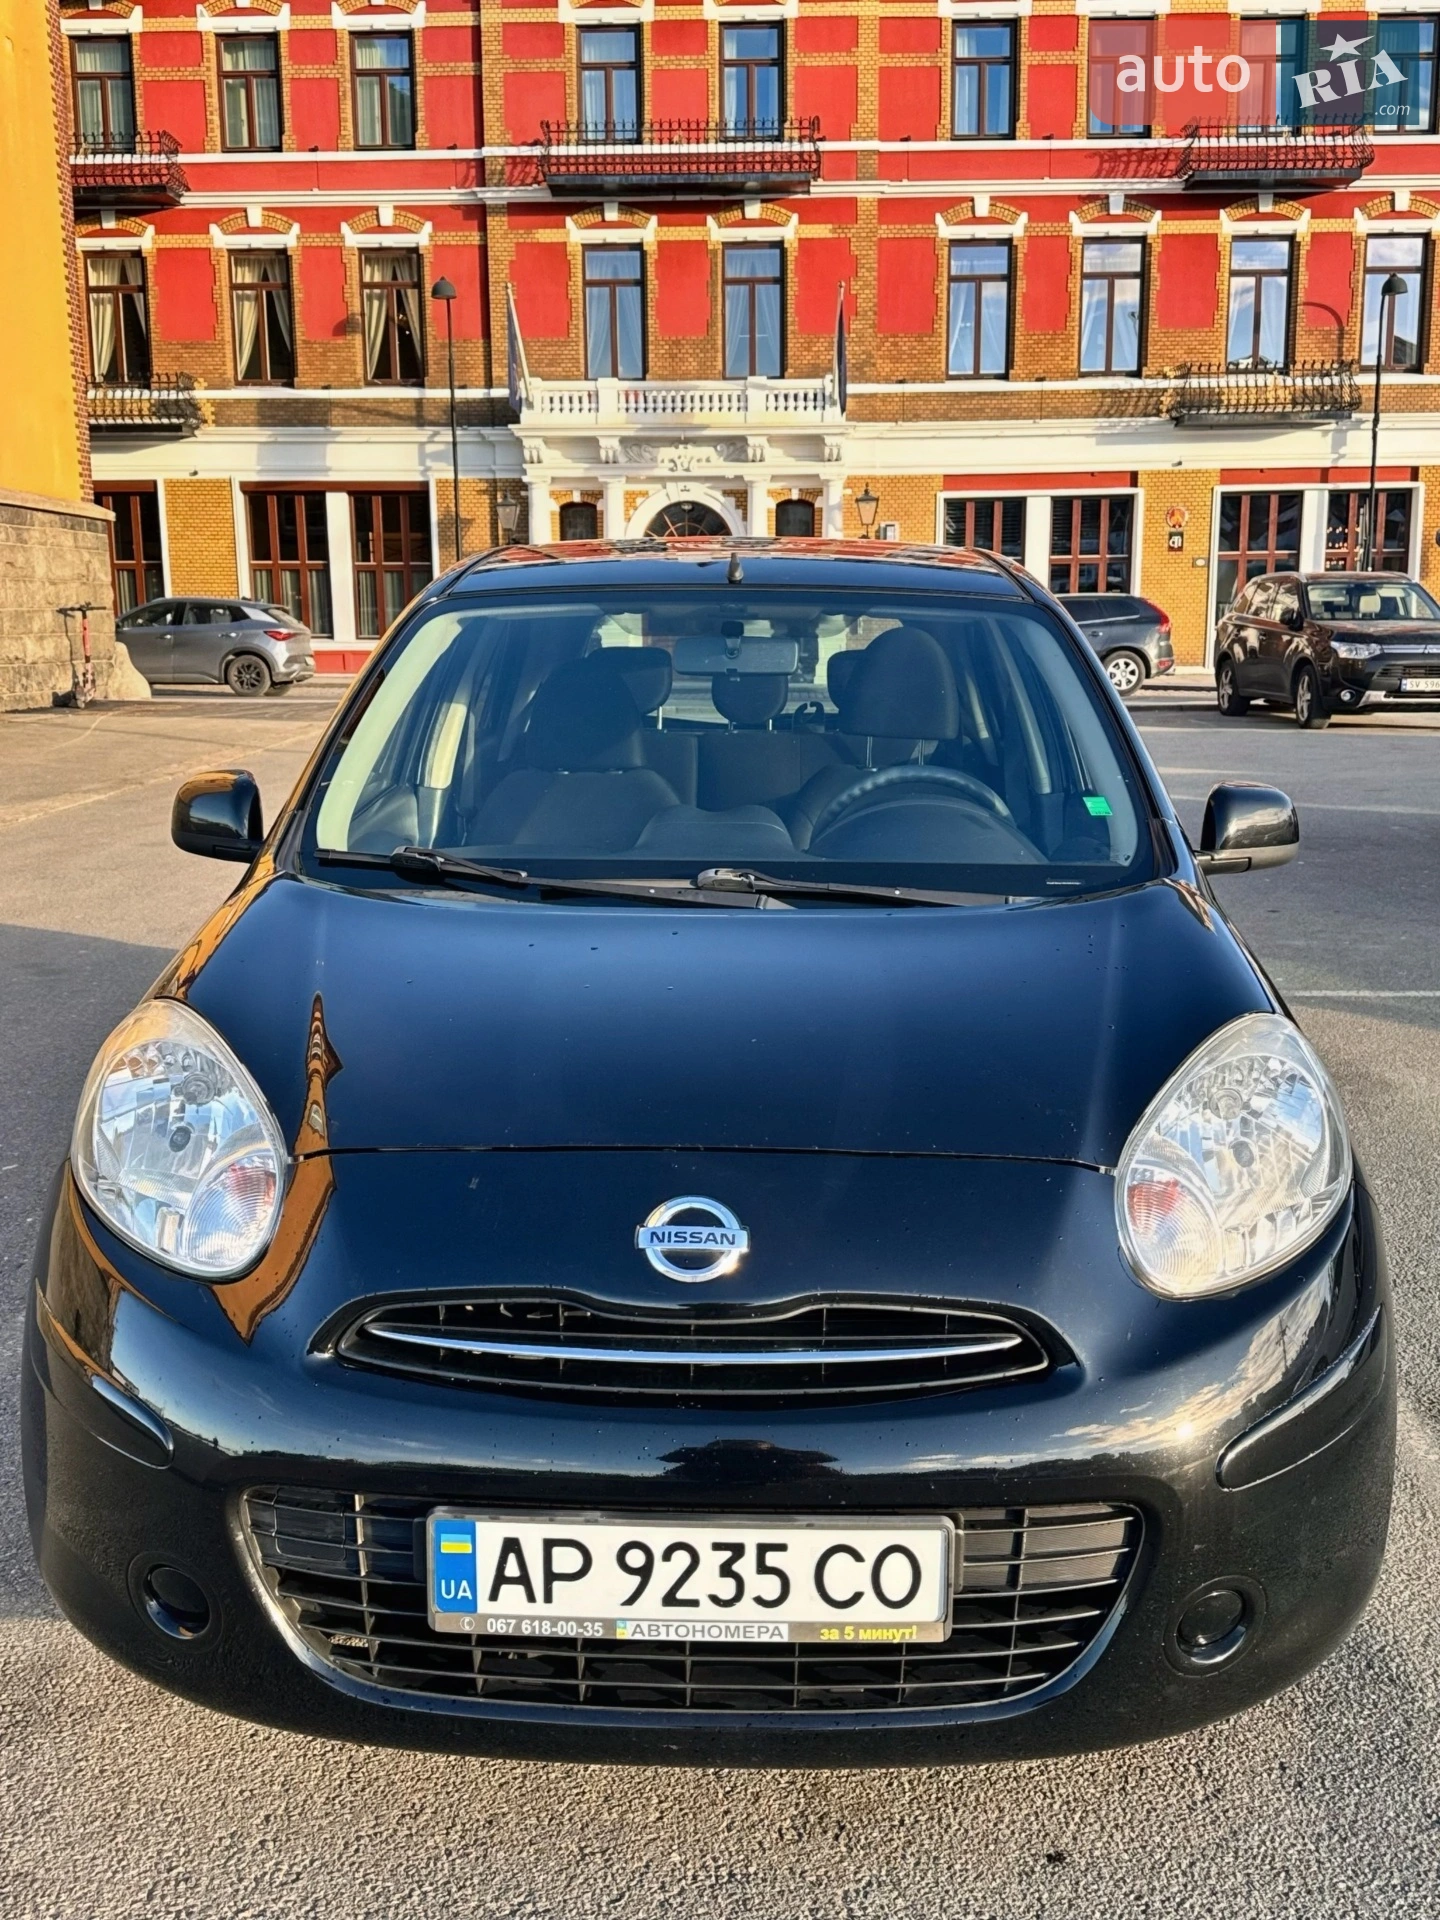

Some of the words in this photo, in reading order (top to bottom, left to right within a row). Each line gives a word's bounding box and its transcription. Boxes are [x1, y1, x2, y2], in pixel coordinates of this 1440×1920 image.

[649, 1231, 736, 1245] NISSAN
[488, 1537, 593, 1604] AP
[616, 1540, 791, 1608] 9235
[814, 1543, 922, 1610] CO
[441, 1579, 472, 1600] UA
[486, 1618, 516, 1633] 067
[521, 1619, 603, 1636] 618-00-35
[631, 1623, 784, 1639] АВТОНОМЕРА
[820, 1628, 839, 1640] за
[844, 1626, 854, 1639] 5
[859, 1625, 917, 1643] минут!
